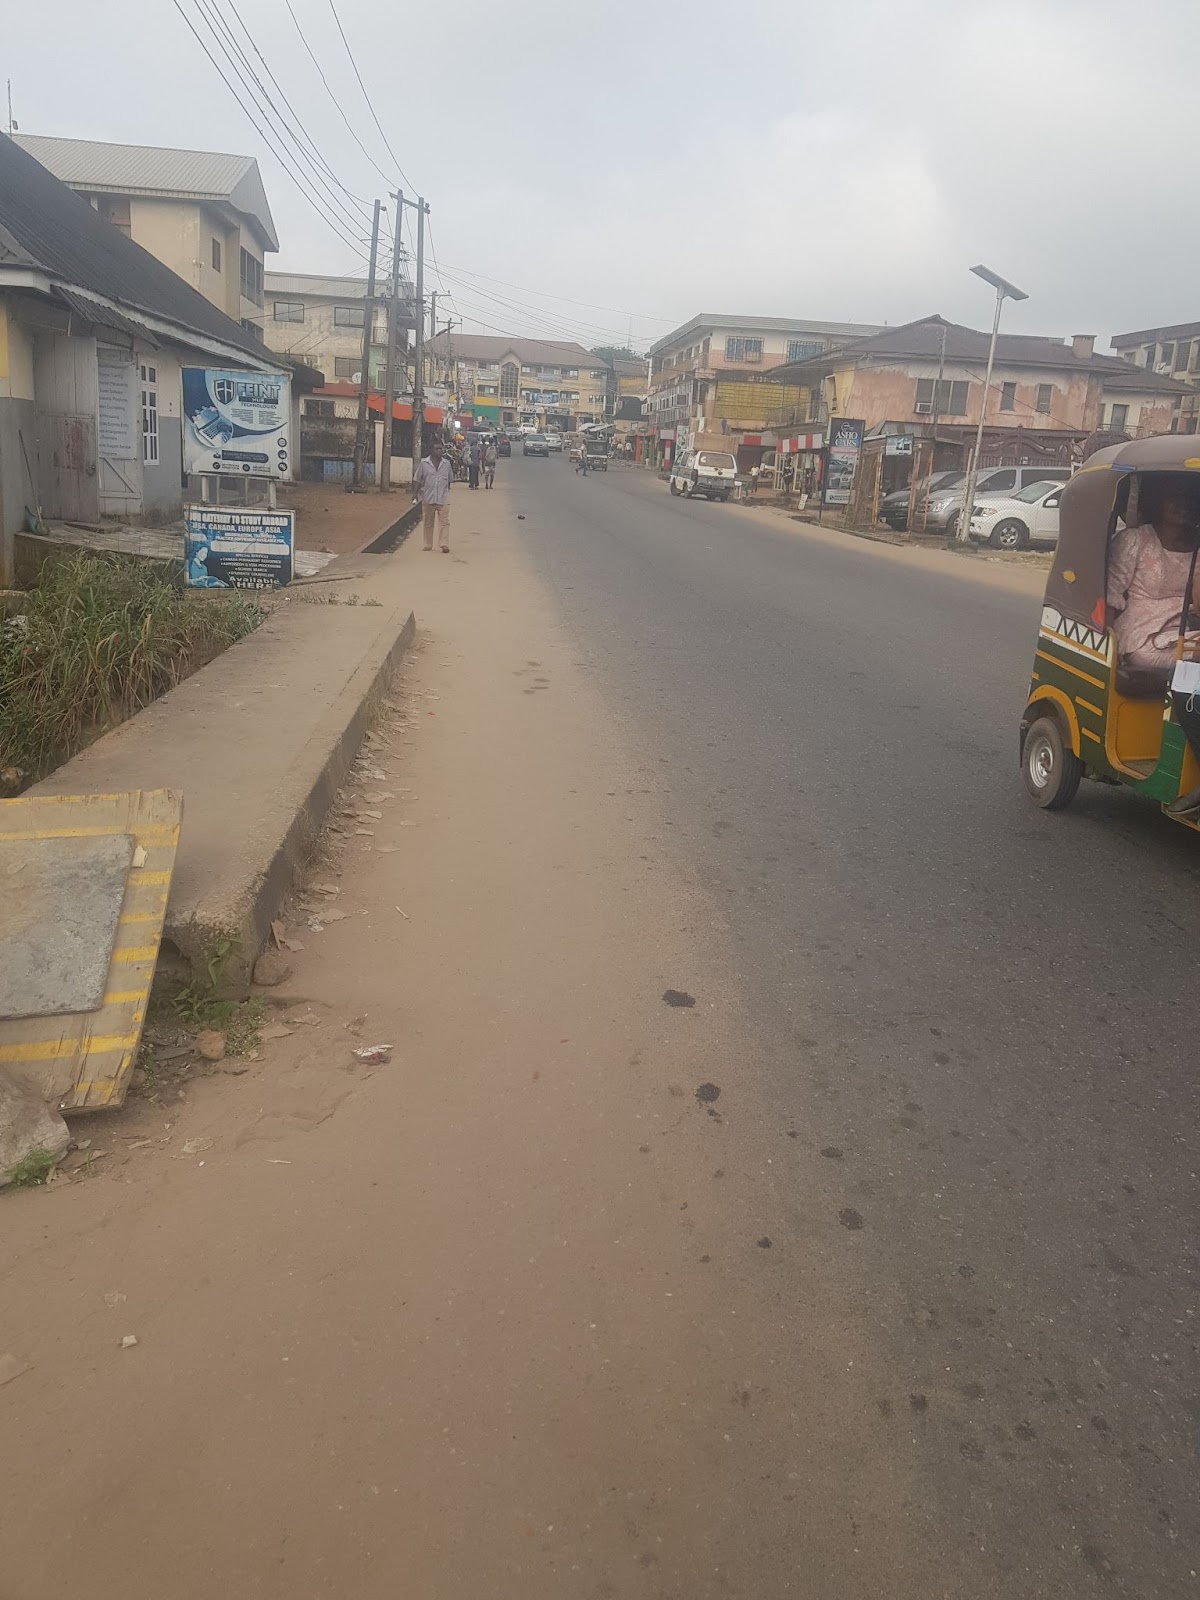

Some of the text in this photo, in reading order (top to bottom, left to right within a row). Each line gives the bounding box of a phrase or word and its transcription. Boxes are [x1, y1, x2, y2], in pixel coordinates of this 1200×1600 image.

[236, 382, 281, 399] FEINT
[835, 431, 858, 439] ASHO
[835, 439, 857, 447] CARS
[202, 513, 230, 524] GATEWAY
[231, 515, 240, 524] TO
[240, 515, 261, 525] STUDY
[262, 516, 288, 527] ABROAD
[229, 576, 280, 585] Available
